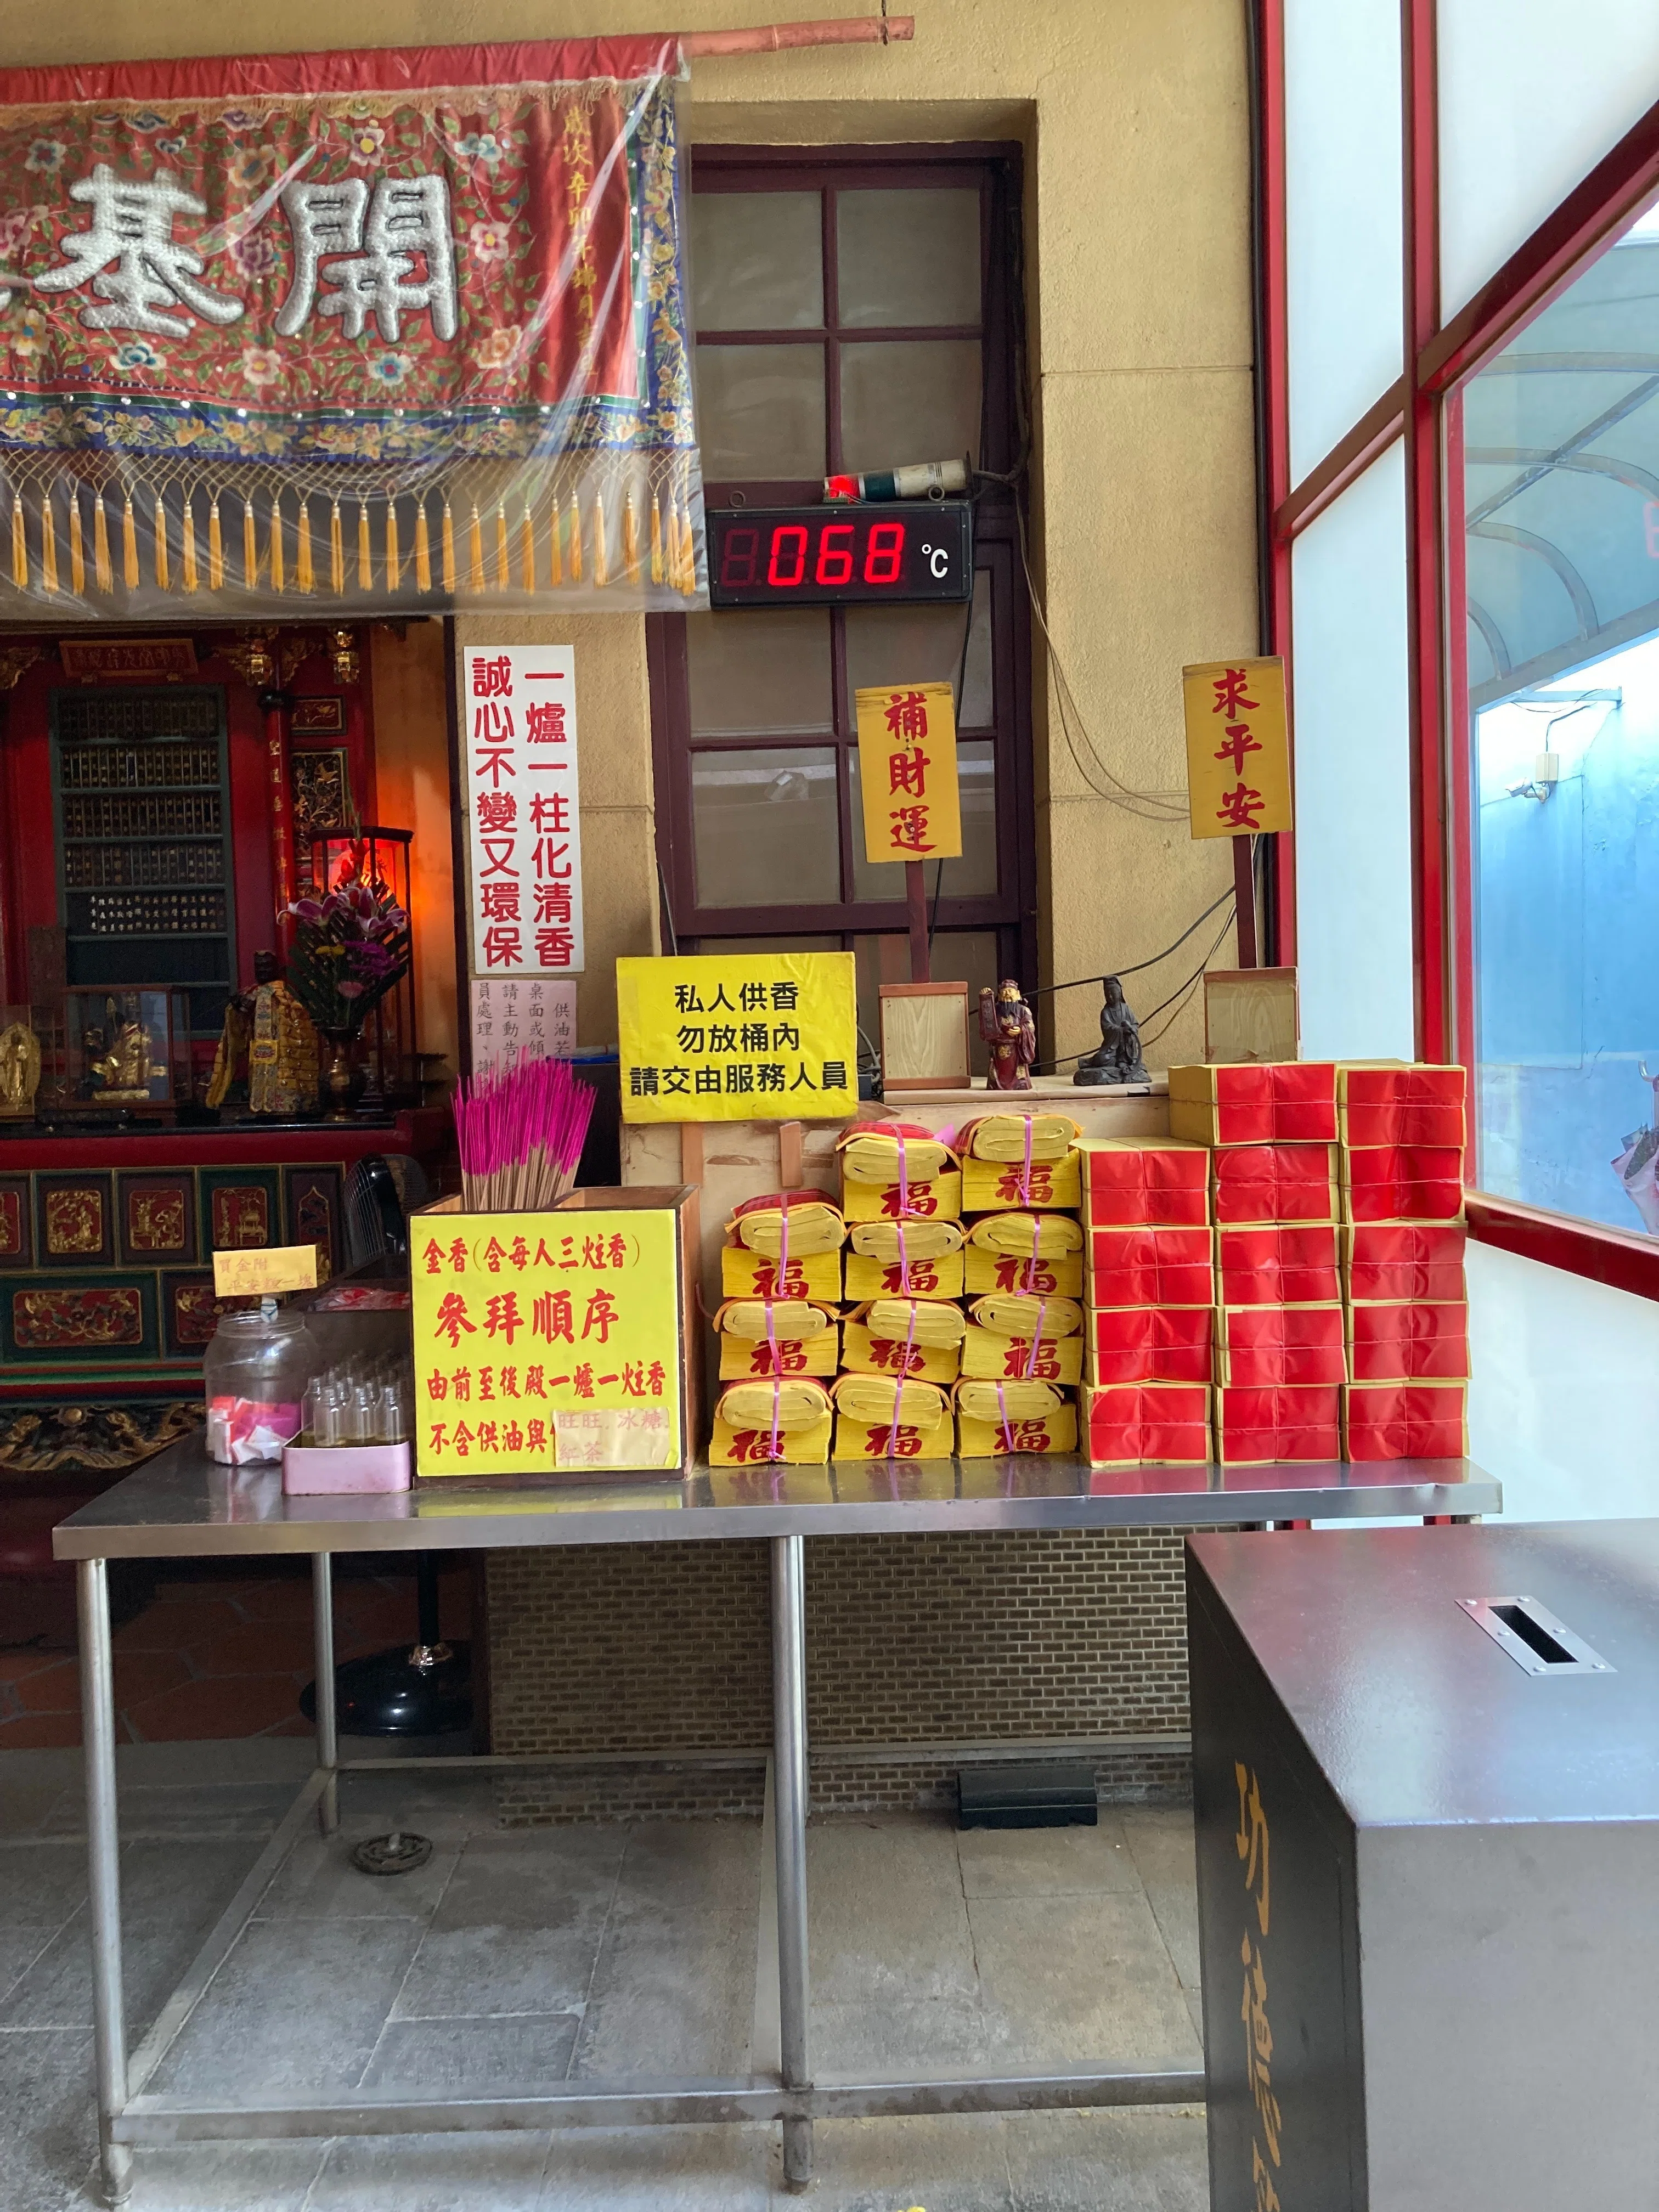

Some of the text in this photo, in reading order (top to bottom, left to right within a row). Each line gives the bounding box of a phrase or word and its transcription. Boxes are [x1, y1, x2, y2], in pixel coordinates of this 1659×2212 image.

[0, 162, 459, 344] 開基
[768, 523, 905, 586] 068
[1212, 668, 1265, 829] 求平安
[883, 691, 938, 853] 補財運
[472, 655, 523, 968] 誠心不變又環保
[524, 672, 574, 967] 一爐一柱化清香
[674, 981, 799, 1014] 私人供香
[676, 1022, 799, 1053] 勿放桶內
[629, 1060, 848, 1096] 請交由服務人員
[881, 1181, 938, 1217] 福
[996, 1165, 1053, 1204] 福
[752, 1260, 809, 1299] 福
[882, 1259, 939, 1294] 福
[994, 1255, 1058, 1294] 福
[434, 1288, 619, 1348] 參拜順序
[751, 1340, 808, 1376] 福
[870, 1339, 927, 1373] 福
[1004, 1336, 1062, 1380] 福
[426, 1360, 666, 1402] 由前至後殿一爐一炷香
[428, 1418, 556, 1457] 不含供油與
[558, 1440, 603, 1463] 紅茶
[727, 1430, 785, 1463] 福
[865, 1424, 922, 1457] 福
[995, 1420, 1051, 1453] 福
